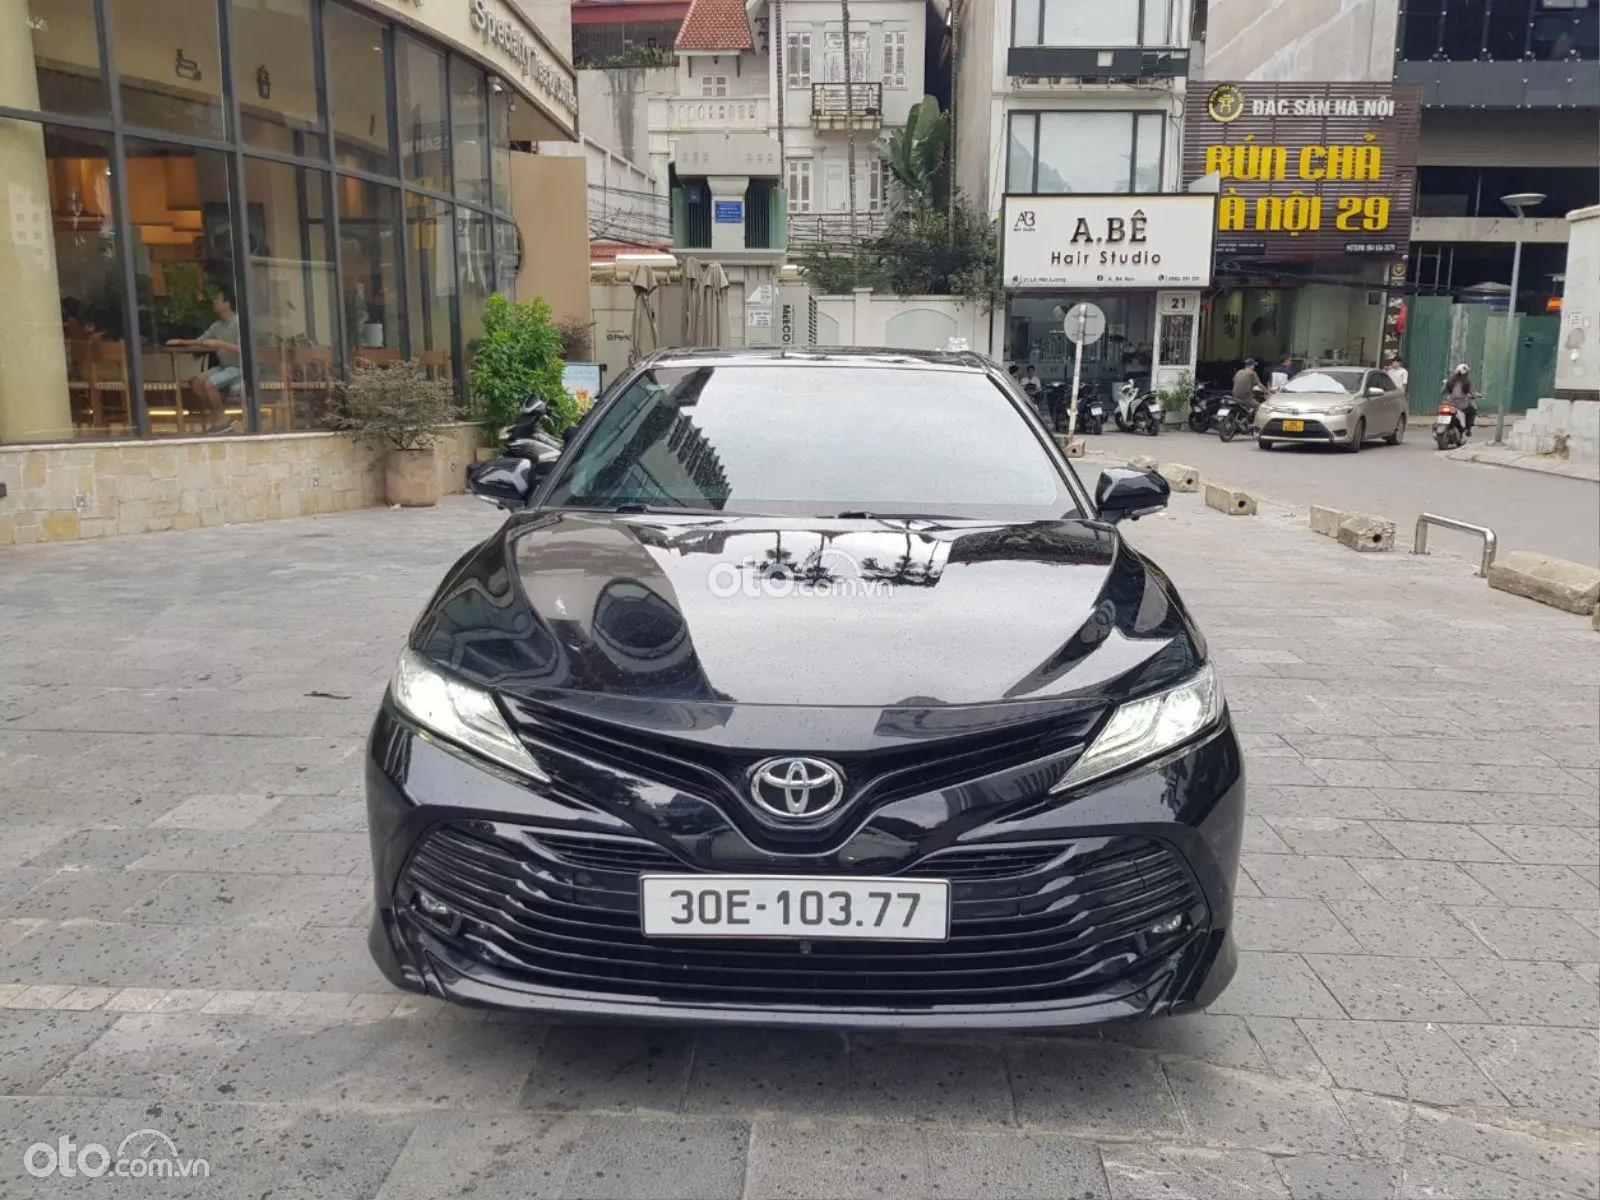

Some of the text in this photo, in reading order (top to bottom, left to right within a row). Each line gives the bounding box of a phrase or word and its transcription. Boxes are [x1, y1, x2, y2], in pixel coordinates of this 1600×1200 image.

[1299, 134, 1382, 180] CHẢ
[1070, 209, 1148, 244] A.BÊ
[1217, 187, 1247, 231] À
[1336, 196, 1390, 231] 29
[1051, 250, 1162, 265] Hair Studio
[1171, 298, 1186, 309] 21
[670, 889, 921, 928] 30E-103.77
